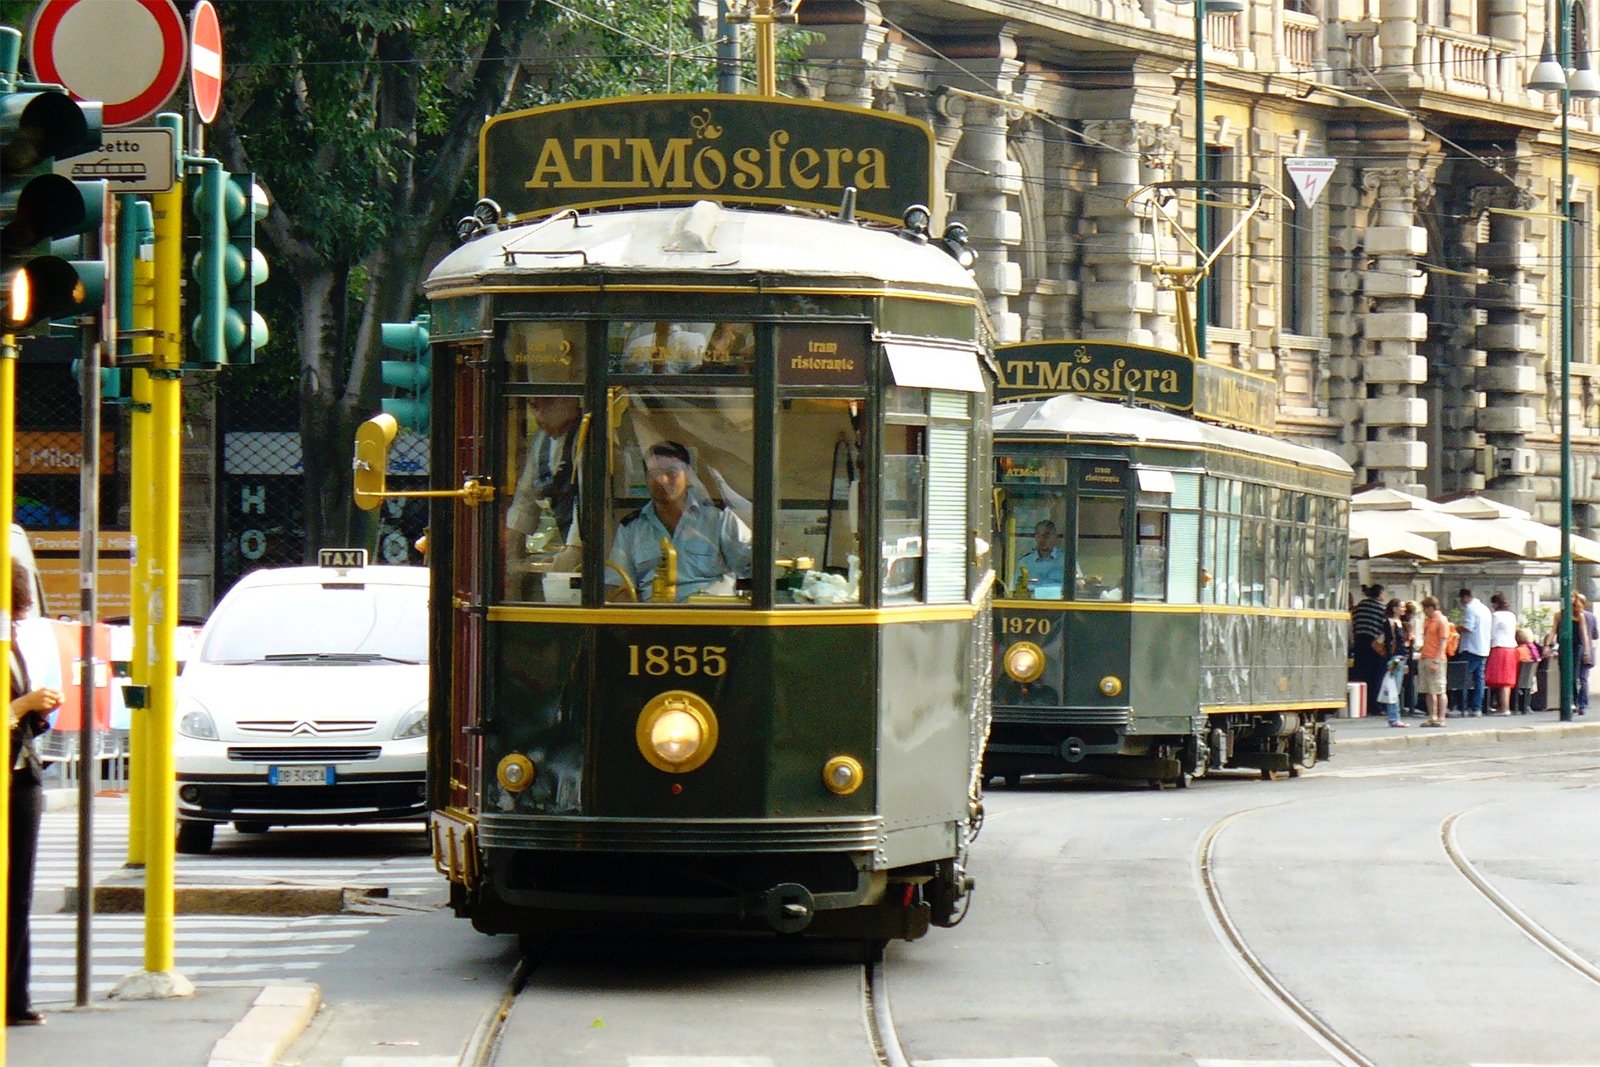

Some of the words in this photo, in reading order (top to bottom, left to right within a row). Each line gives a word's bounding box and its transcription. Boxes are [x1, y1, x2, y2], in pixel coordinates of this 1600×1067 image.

[98, 141, 140, 153] cetto
[524, 129, 891, 190] ATMosfera
[806, 341, 838, 355] tram
[791, 356, 855, 372] ristorante
[322, 552, 362, 566] TAXI
[1001, 616, 1050, 635] 1970
[628, 644, 728, 677] 1855
